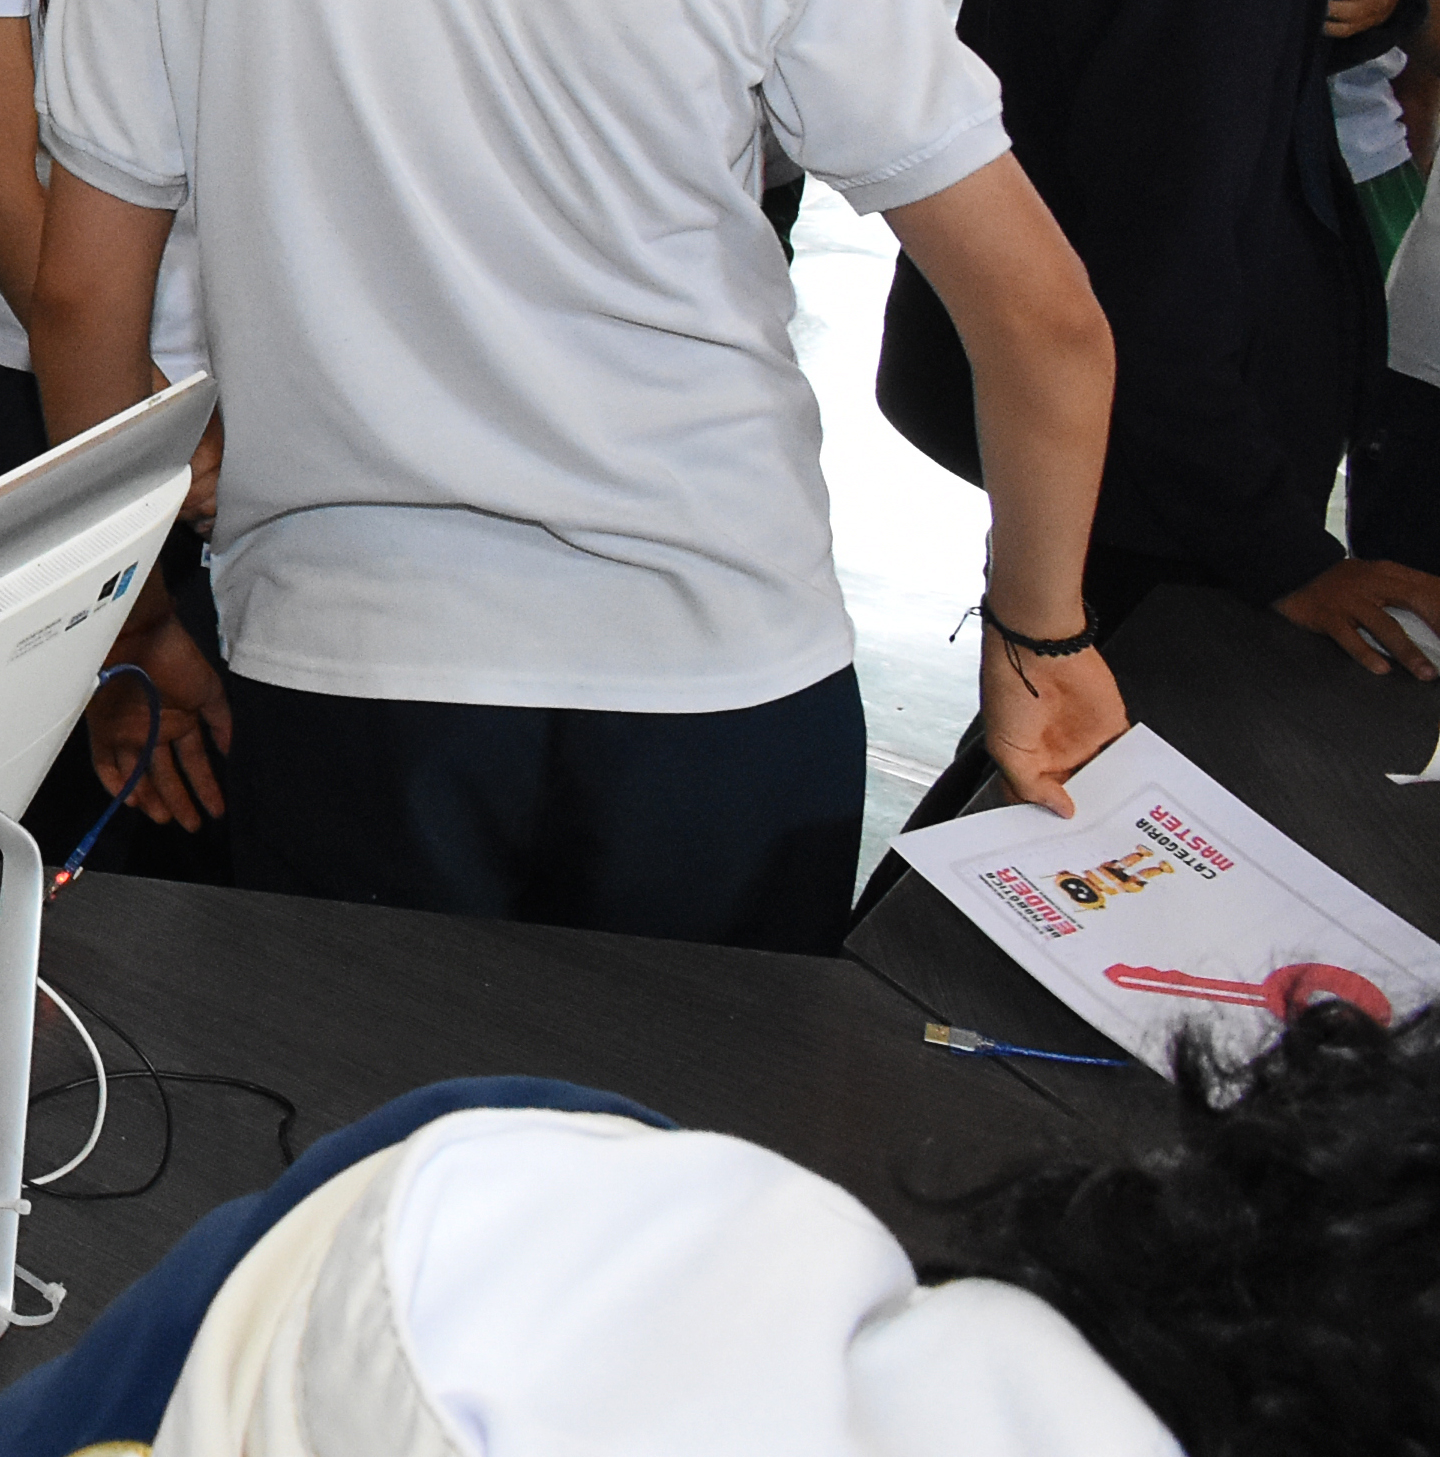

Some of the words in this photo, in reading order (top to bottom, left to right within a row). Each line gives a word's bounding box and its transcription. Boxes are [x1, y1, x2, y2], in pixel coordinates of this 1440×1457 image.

[1135, 817, 1218, 880] CATEGORIA
[1149, 804, 1235, 872] MASTER
[996, 867, 1078, 936] ENDER
